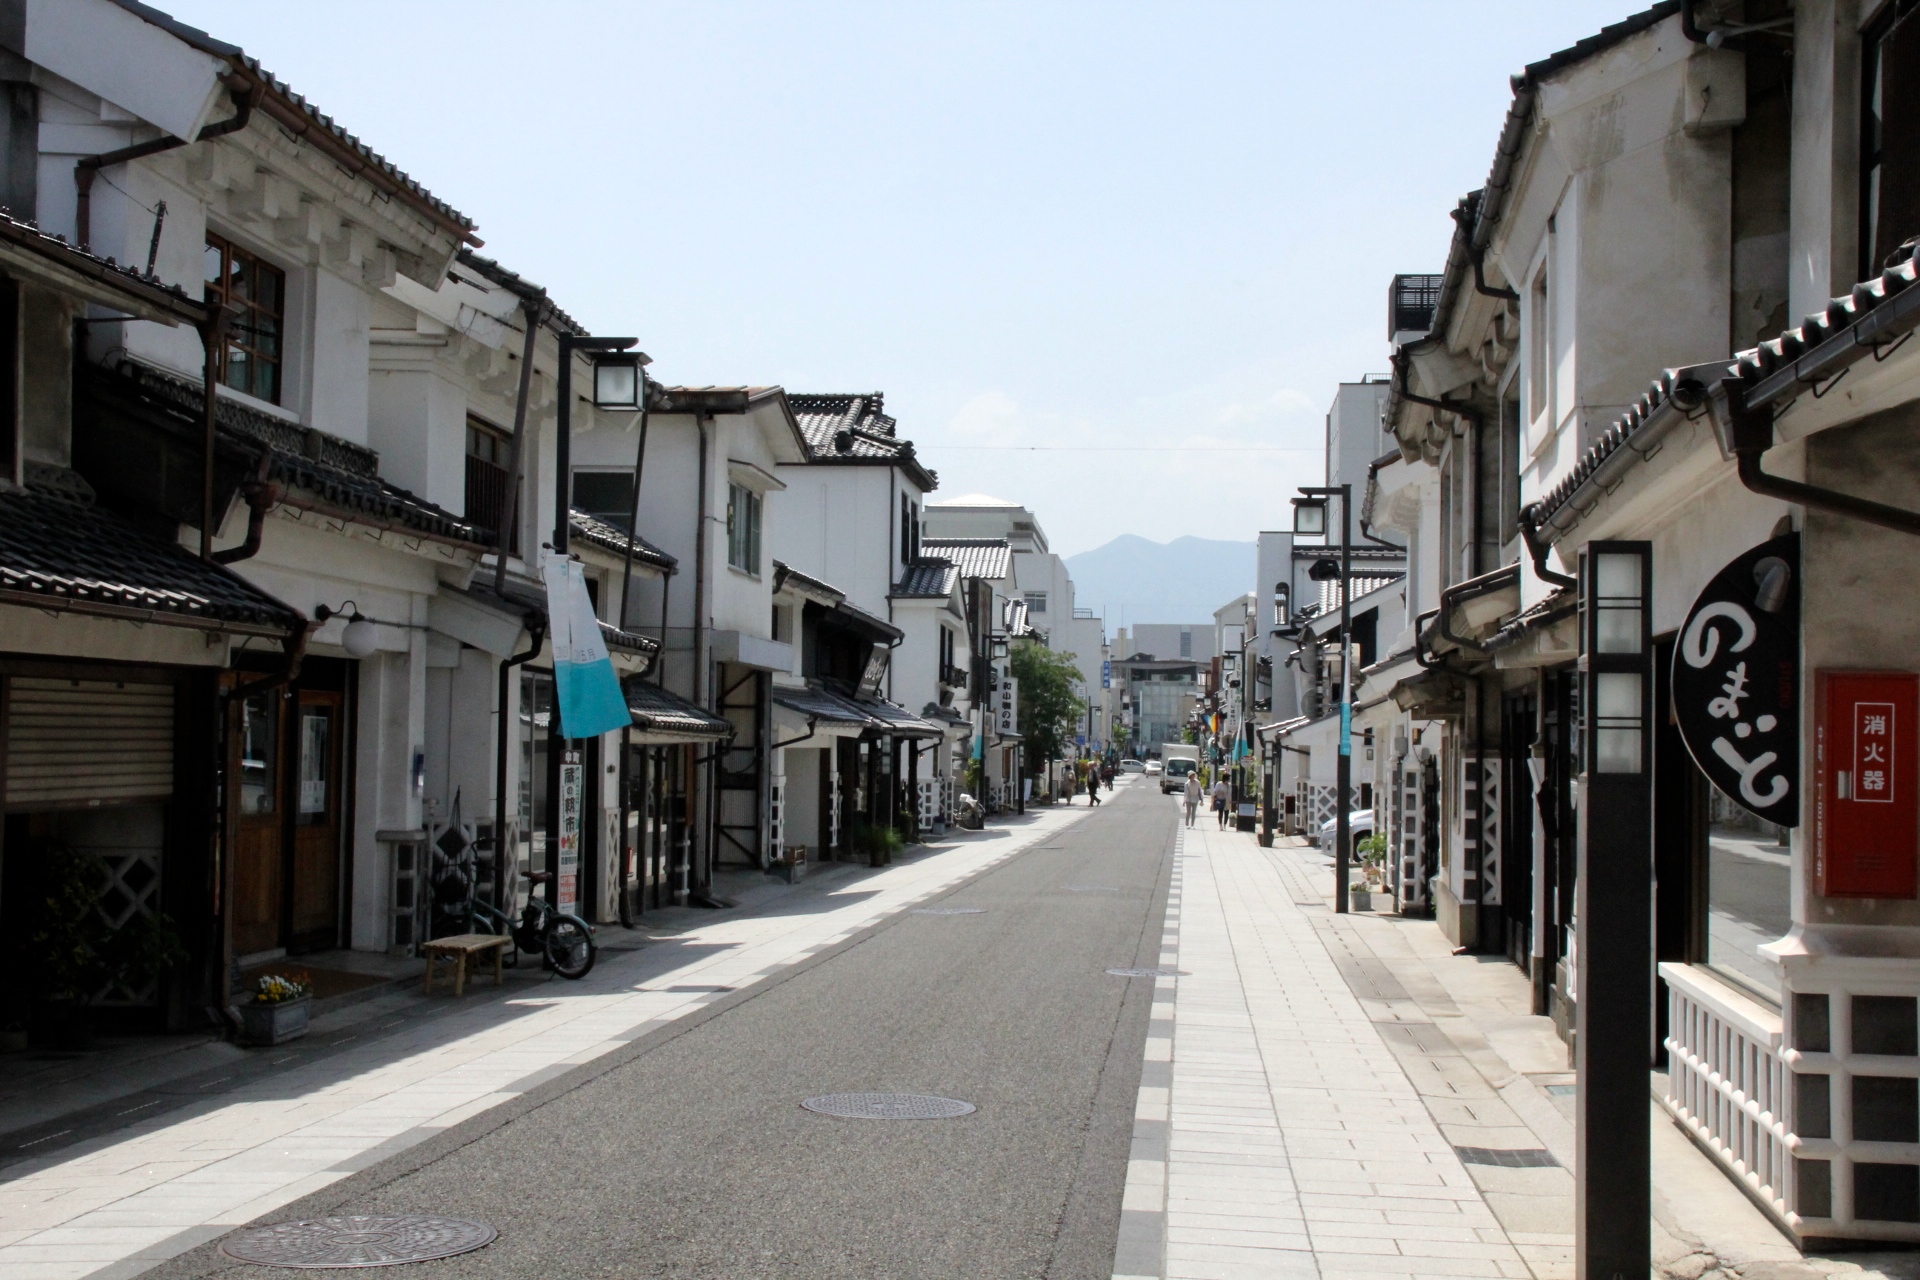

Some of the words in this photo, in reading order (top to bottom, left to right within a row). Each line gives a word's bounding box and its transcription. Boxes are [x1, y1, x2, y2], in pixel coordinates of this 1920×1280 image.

[1863, 715, 1886, 791] 消火器
[564, 767, 576, 833] 蔵の朝市
